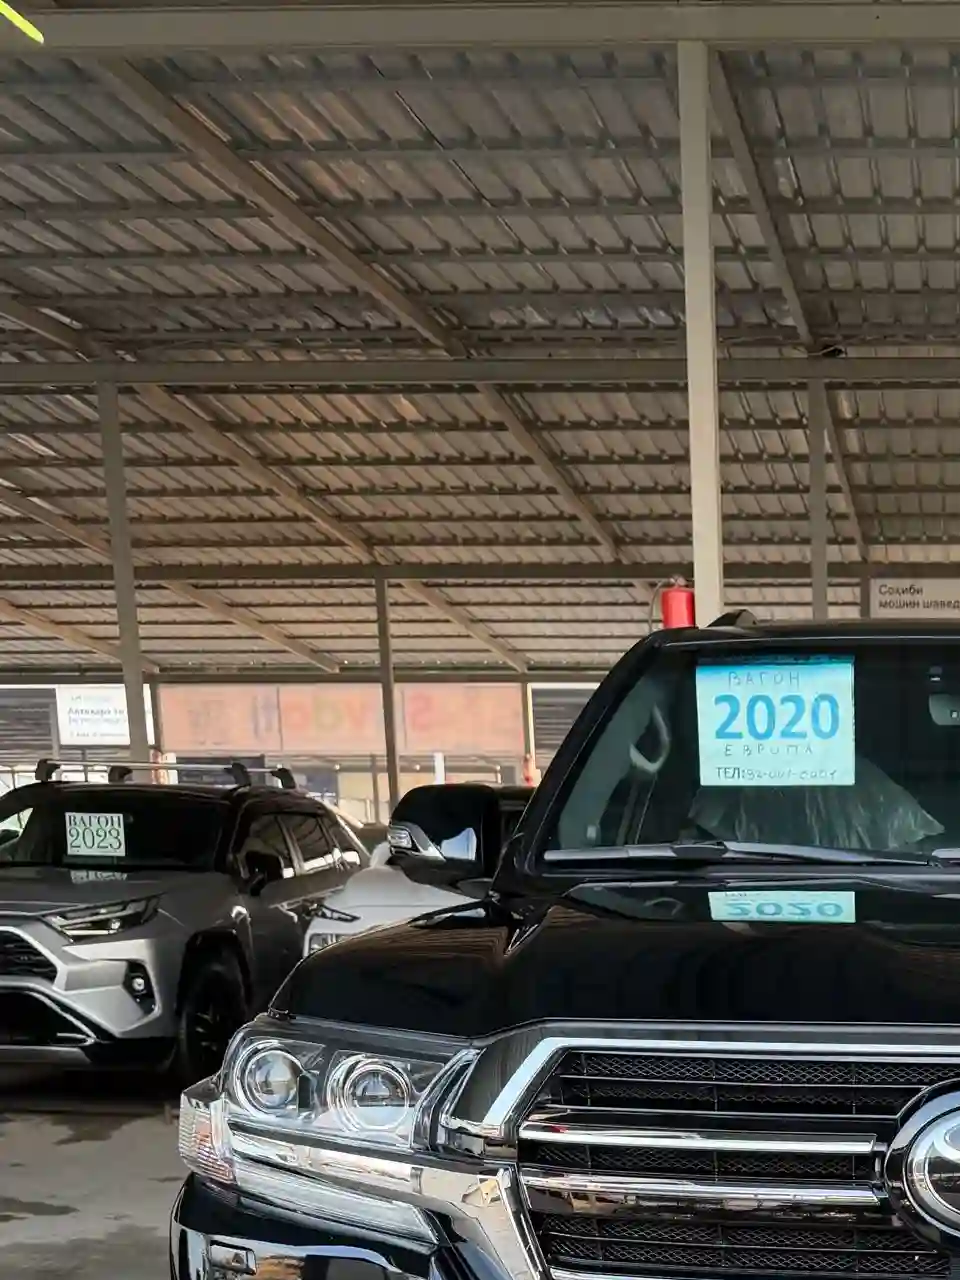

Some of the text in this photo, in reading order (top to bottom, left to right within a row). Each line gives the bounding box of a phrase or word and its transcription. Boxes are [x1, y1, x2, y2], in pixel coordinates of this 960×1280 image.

[728, 671, 800, 689] ВАГОН
[714, 693, 840, 740] 2020
[724, 743, 814, 757] ЕВРОПА
[68, 815, 122, 828] ВАГОН
